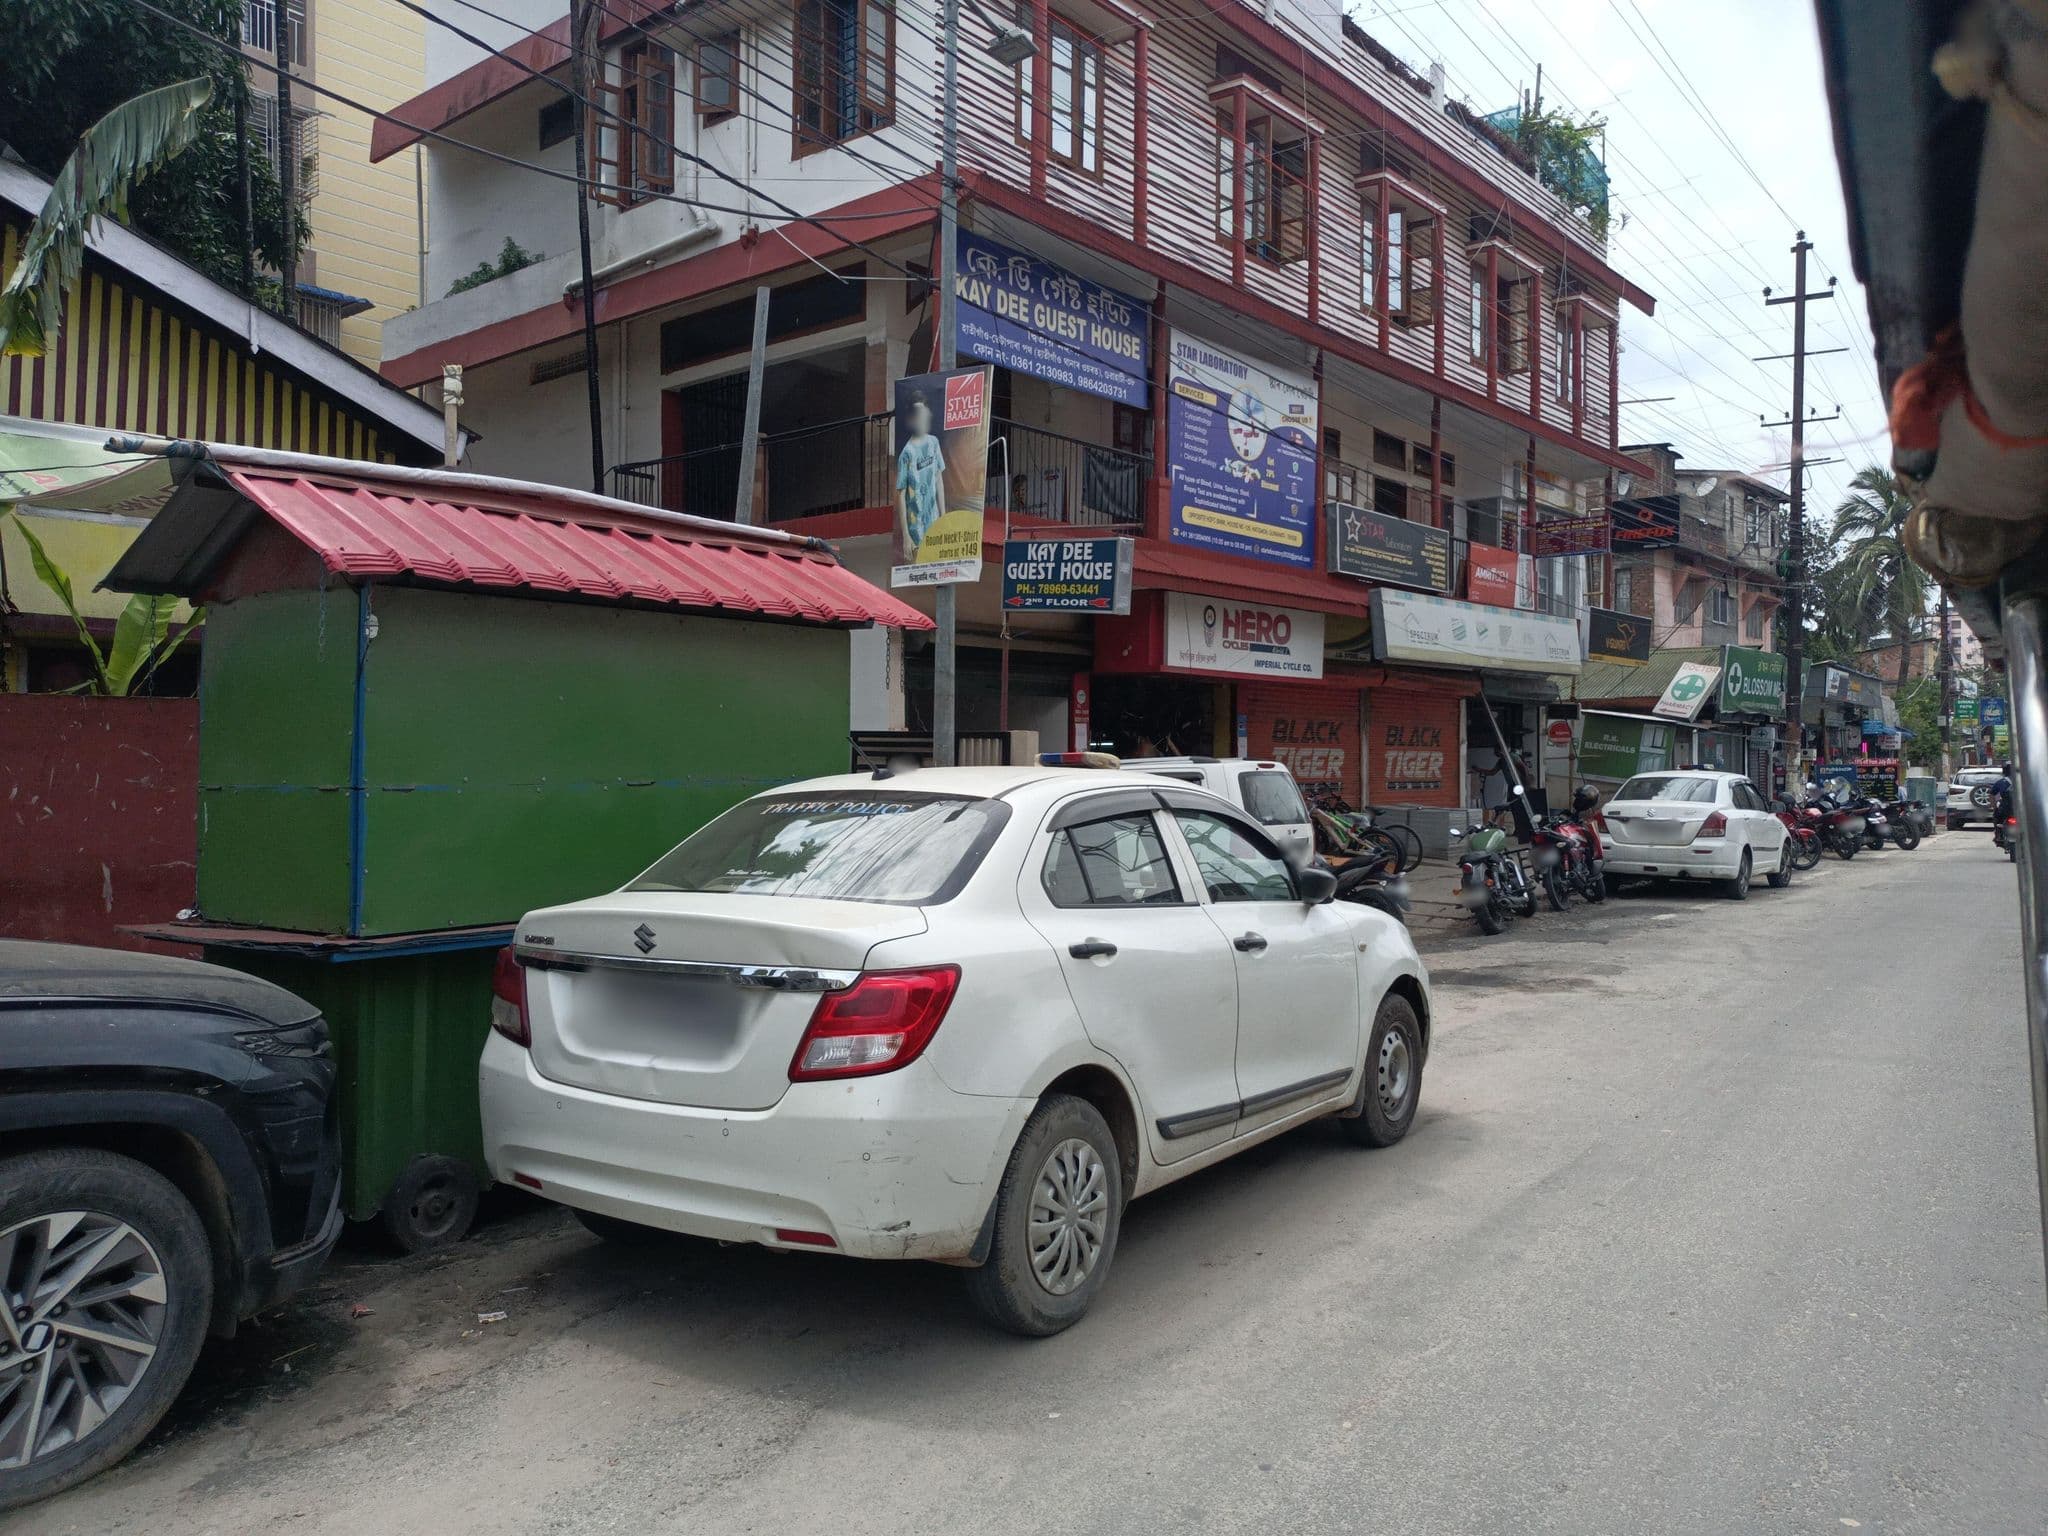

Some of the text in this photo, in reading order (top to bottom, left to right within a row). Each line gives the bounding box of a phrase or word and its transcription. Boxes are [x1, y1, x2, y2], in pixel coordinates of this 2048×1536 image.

[955, 273, 992, 309] KAY
[997, 288, 1029, 323] DEE
[1034, 303, 1087, 341] GUEST
[1091, 322, 1140, 361] HOUSE
[1177, 342, 1248, 381] STAR LABORATORY
[1011, 355, 1033, 372] 0361
[1078, 375, 1127, 399] 9864203731
[948, 394, 980, 412] STYLE
[946, 408, 979, 423] BAAZAR
[1360, 516, 1385, 542] STAR
[1027, 543, 1094, 561] KAY DEE
[1007, 562, 1113, 582] GUEST HOUSE
[1038, 583, 1099, 595] 78969-63441
[1046, 597, 1089, 607] FLOOR
[1222, 607, 1292, 645] HERO
[1222, 640, 1249, 651] CYCLES
[1254, 659, 1312, 673] IMPERIAL CYCLE CO.
[1743, 676, 1772, 697] BLOSSOM
[1272, 718, 1343, 744] BLACK
[1385, 724, 1442, 747] BLACK
[1584, 741, 1636, 754] ELECTRICALS
[1272, 746, 1345, 778] TIGER
[1385, 750, 1444, 778] TIGER
[760, 801, 912, 816] TRAFFIC POLICE
